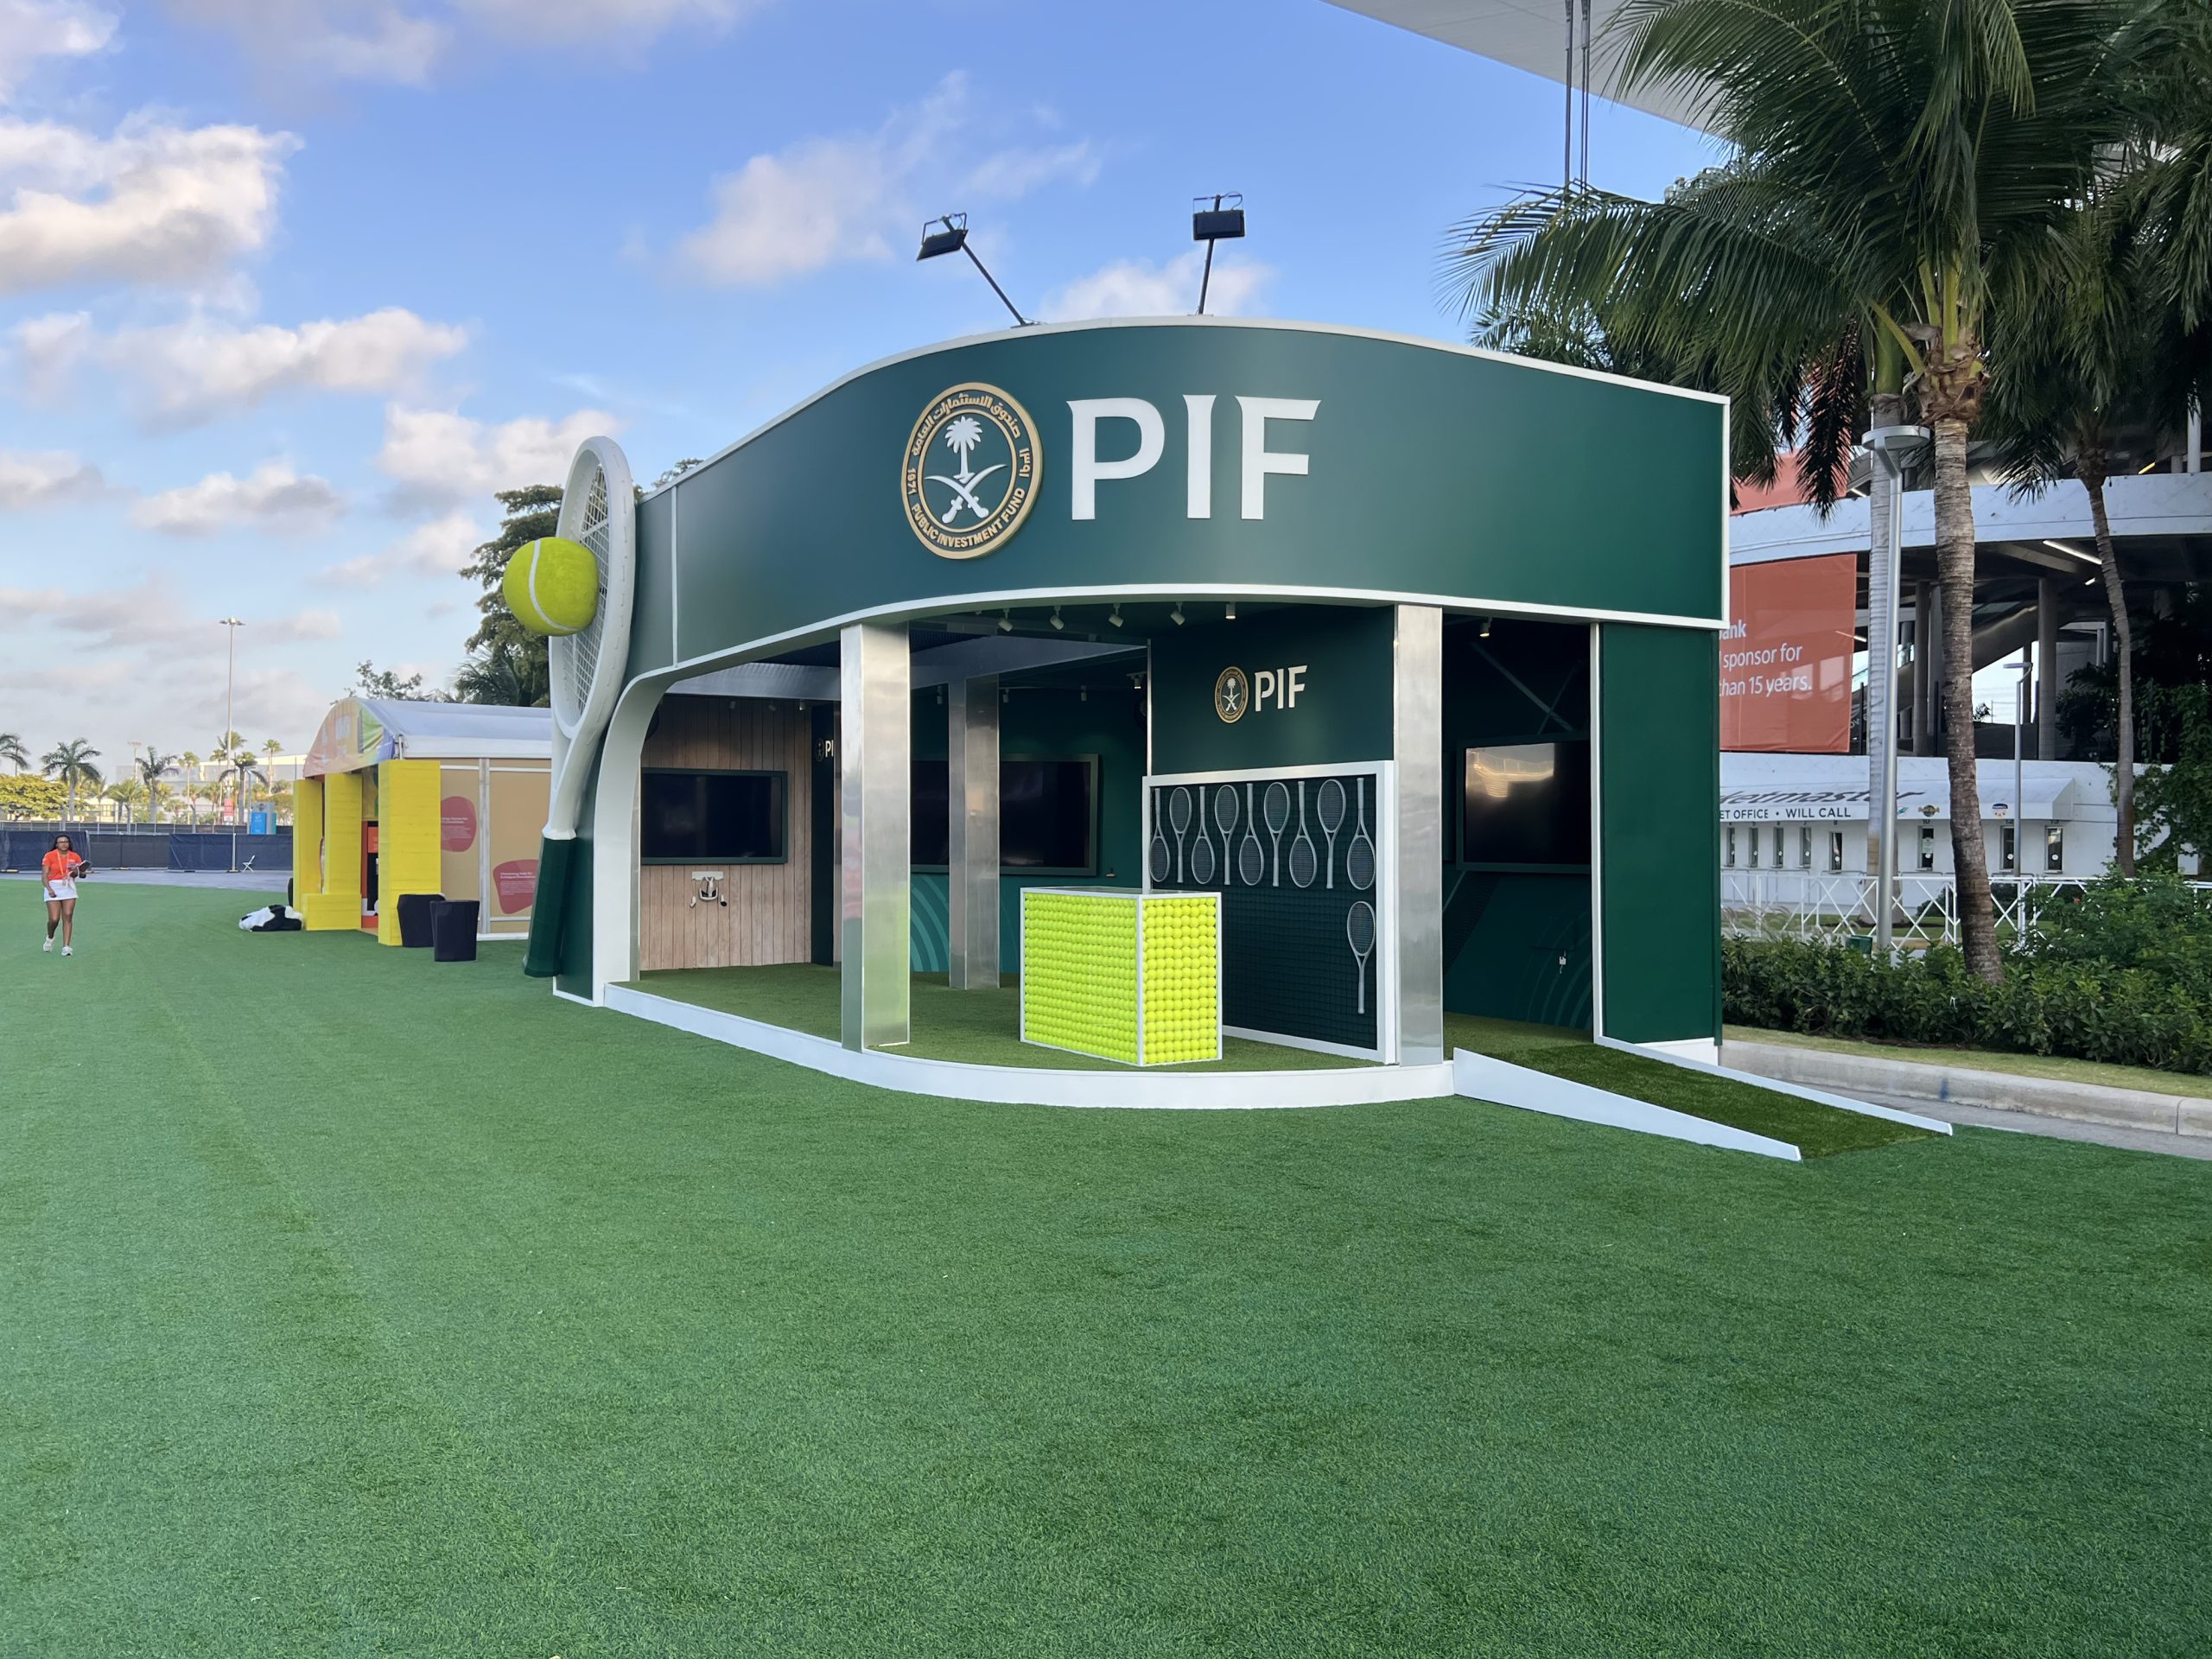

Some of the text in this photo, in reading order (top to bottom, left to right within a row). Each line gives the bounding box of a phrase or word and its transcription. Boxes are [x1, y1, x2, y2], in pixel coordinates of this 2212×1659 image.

[990, 402, 1021, 438] صندوق
[1066, 395, 1322, 520] PIF
[907, 467, 917, 495] 1971
[912, 487, 1026, 548] PUBLIC INVESTMENT FUND
[1719, 619, 1746, 639] ank
[1723, 646, 1777, 671] sponsor
[1780, 643, 1802, 662] for
[1255, 665, 1308, 712] PIF
[1749, 675, 1764, 695] 15
[1766, 675, 1813, 697] years.
[1733, 809, 1769, 819] OFFICE
[1785, 808, 1815, 818] WILL
[1818, 807, 1851, 817] CALL
